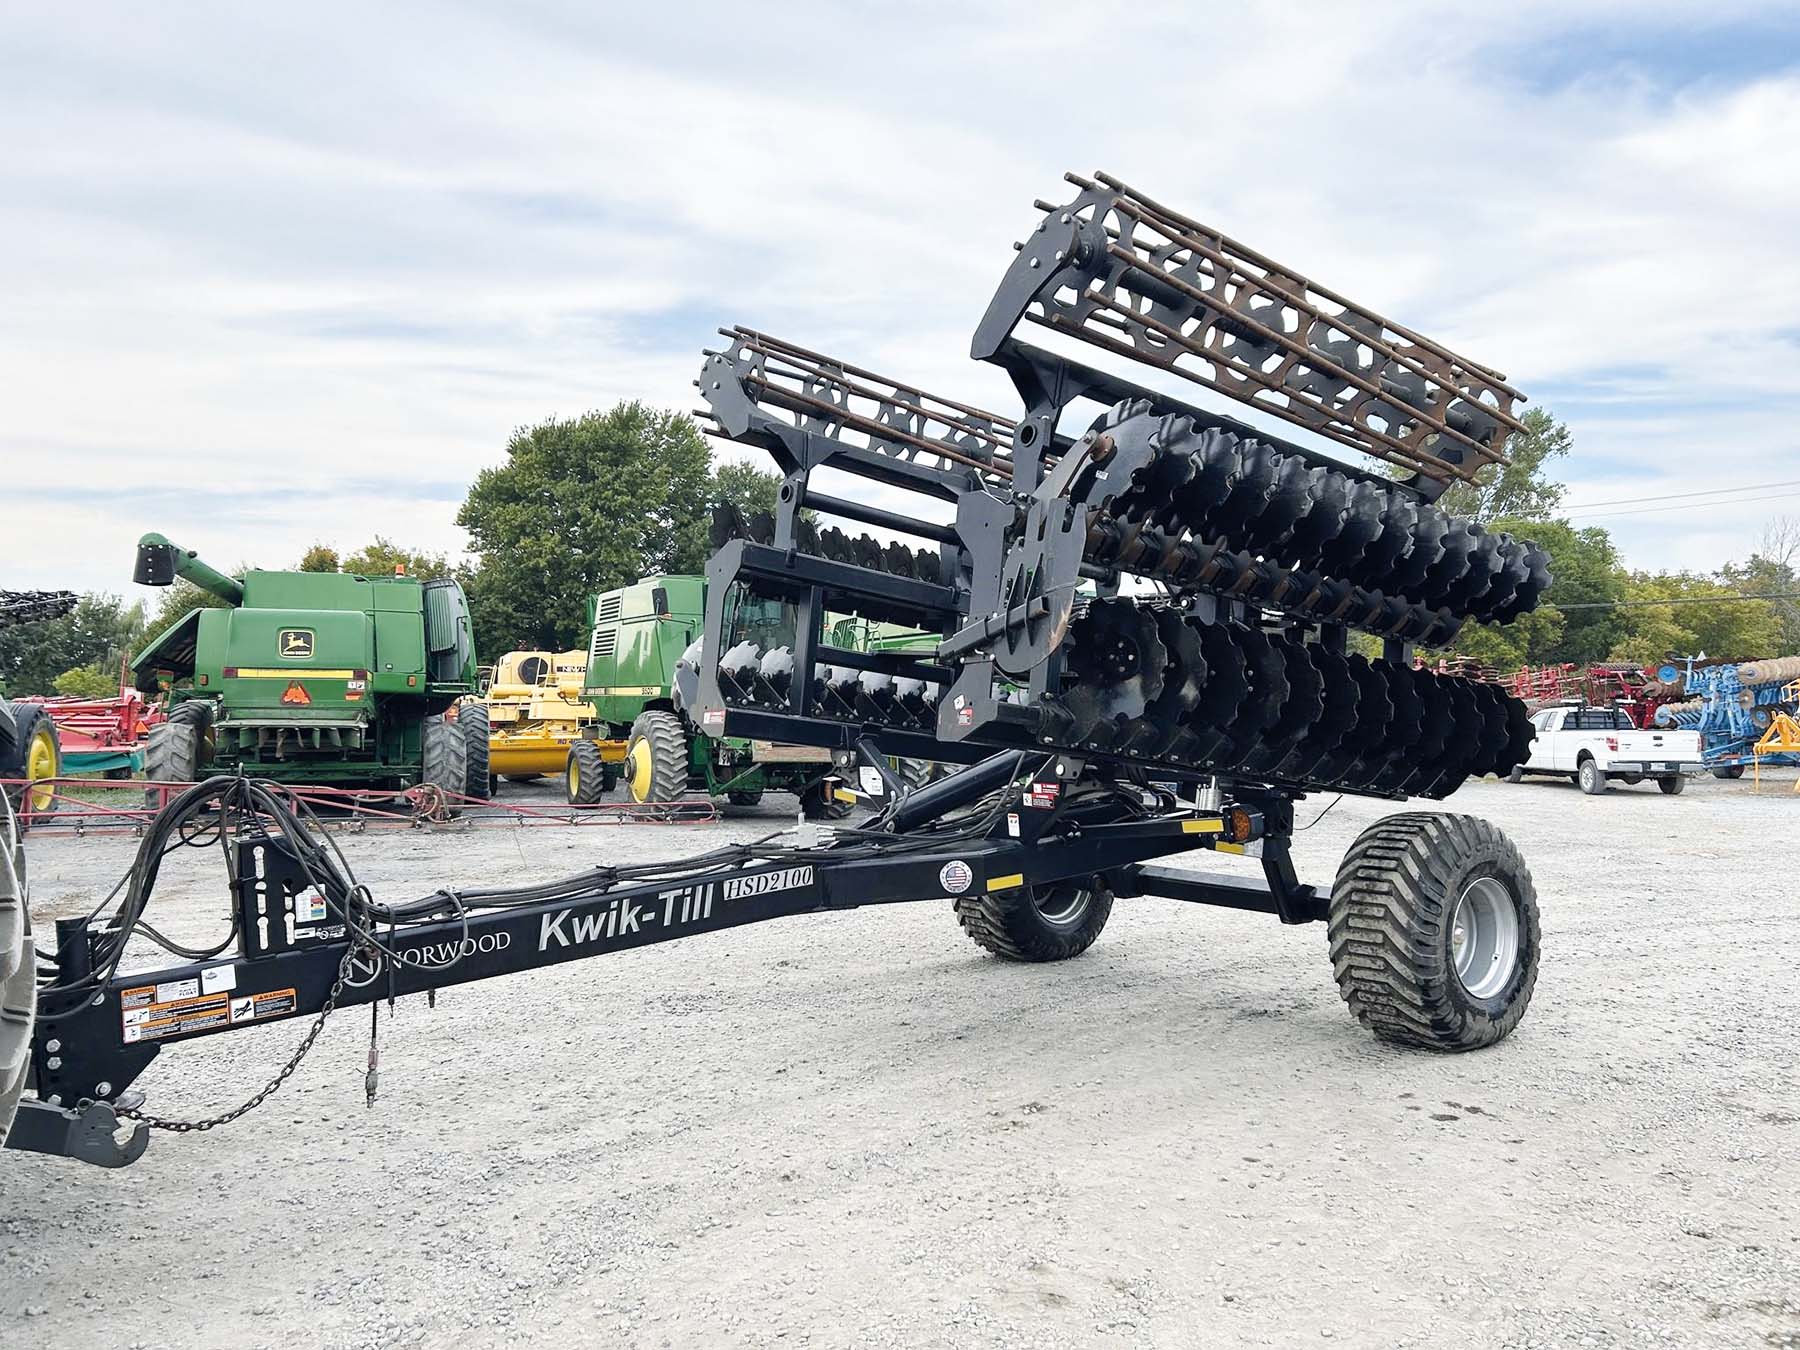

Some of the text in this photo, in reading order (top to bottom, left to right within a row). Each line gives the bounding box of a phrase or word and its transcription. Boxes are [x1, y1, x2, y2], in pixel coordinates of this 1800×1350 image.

[727, 867, 812, 899] HSD2100
[538, 883, 714, 951] Kwik-Till
[384, 932, 511, 973] NORWOOD
